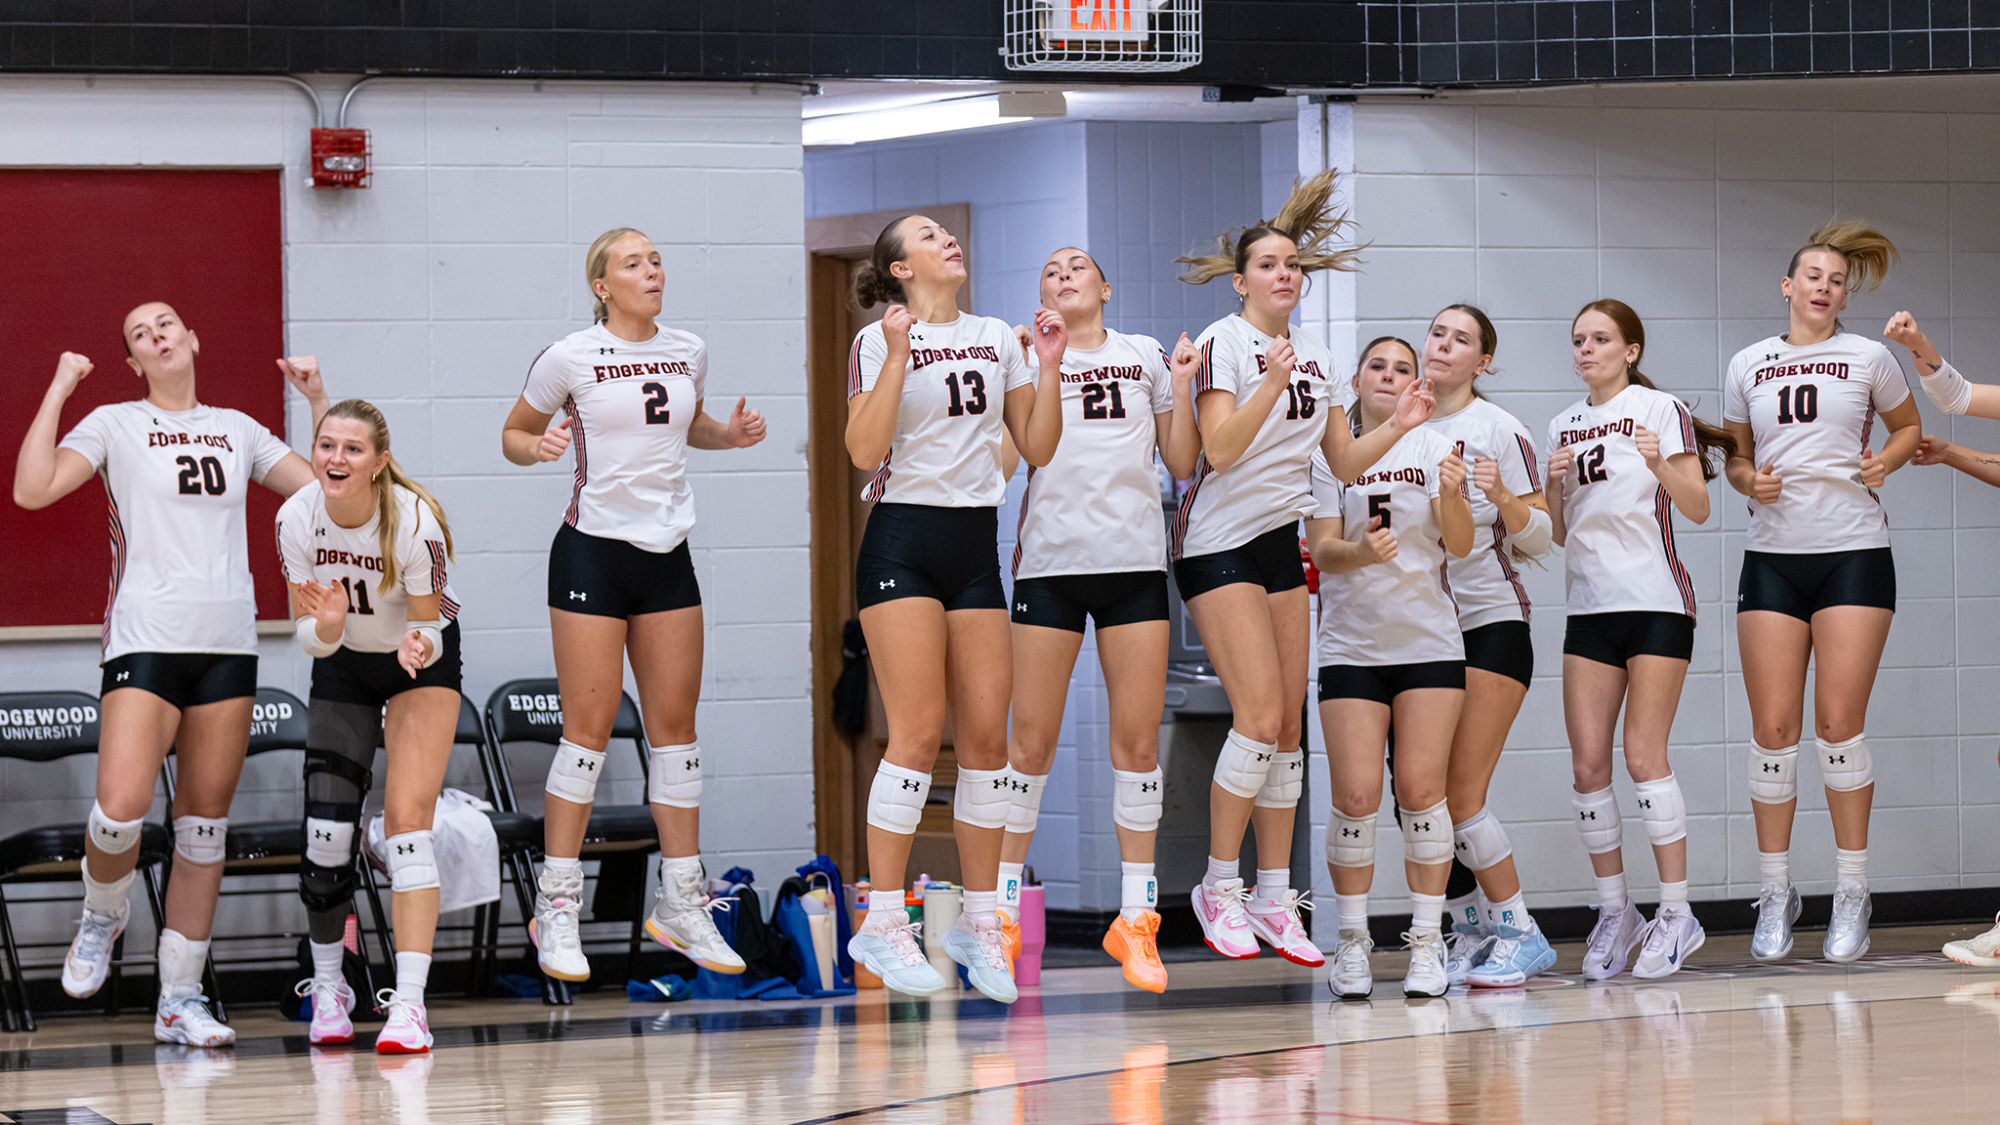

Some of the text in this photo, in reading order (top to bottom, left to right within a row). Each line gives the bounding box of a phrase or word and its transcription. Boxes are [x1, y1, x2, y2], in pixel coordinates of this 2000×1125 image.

[912, 346, 999, 371] EDGEWOOD
[593, 361, 692, 384] EDGEWOOD
[1060, 364, 1142, 383] DGEWOOD
[1753, 362, 1849, 387] EDGEWOOD
[641, 382, 670, 425] 2
[945, 370, 987, 417] 13
[1081, 381, 1126, 420] 21
[1286, 379, 1316, 420] 16
[1777, 383, 1818, 425] 10
[175, 455, 227, 496] 20
[1577, 443, 1608, 486] 12
[1346, 467, 1425, 488] GEWOOD
[1368, 493, 1391, 531] 5
[315, 548, 384, 573] DGEWOO
[508, 694, 561, 711] EDGE
[0, 706, 98, 726] DGEWOOD
[527, 711, 563, 725] UNIVE
[2, 724, 82, 740] UNIVERSITY
